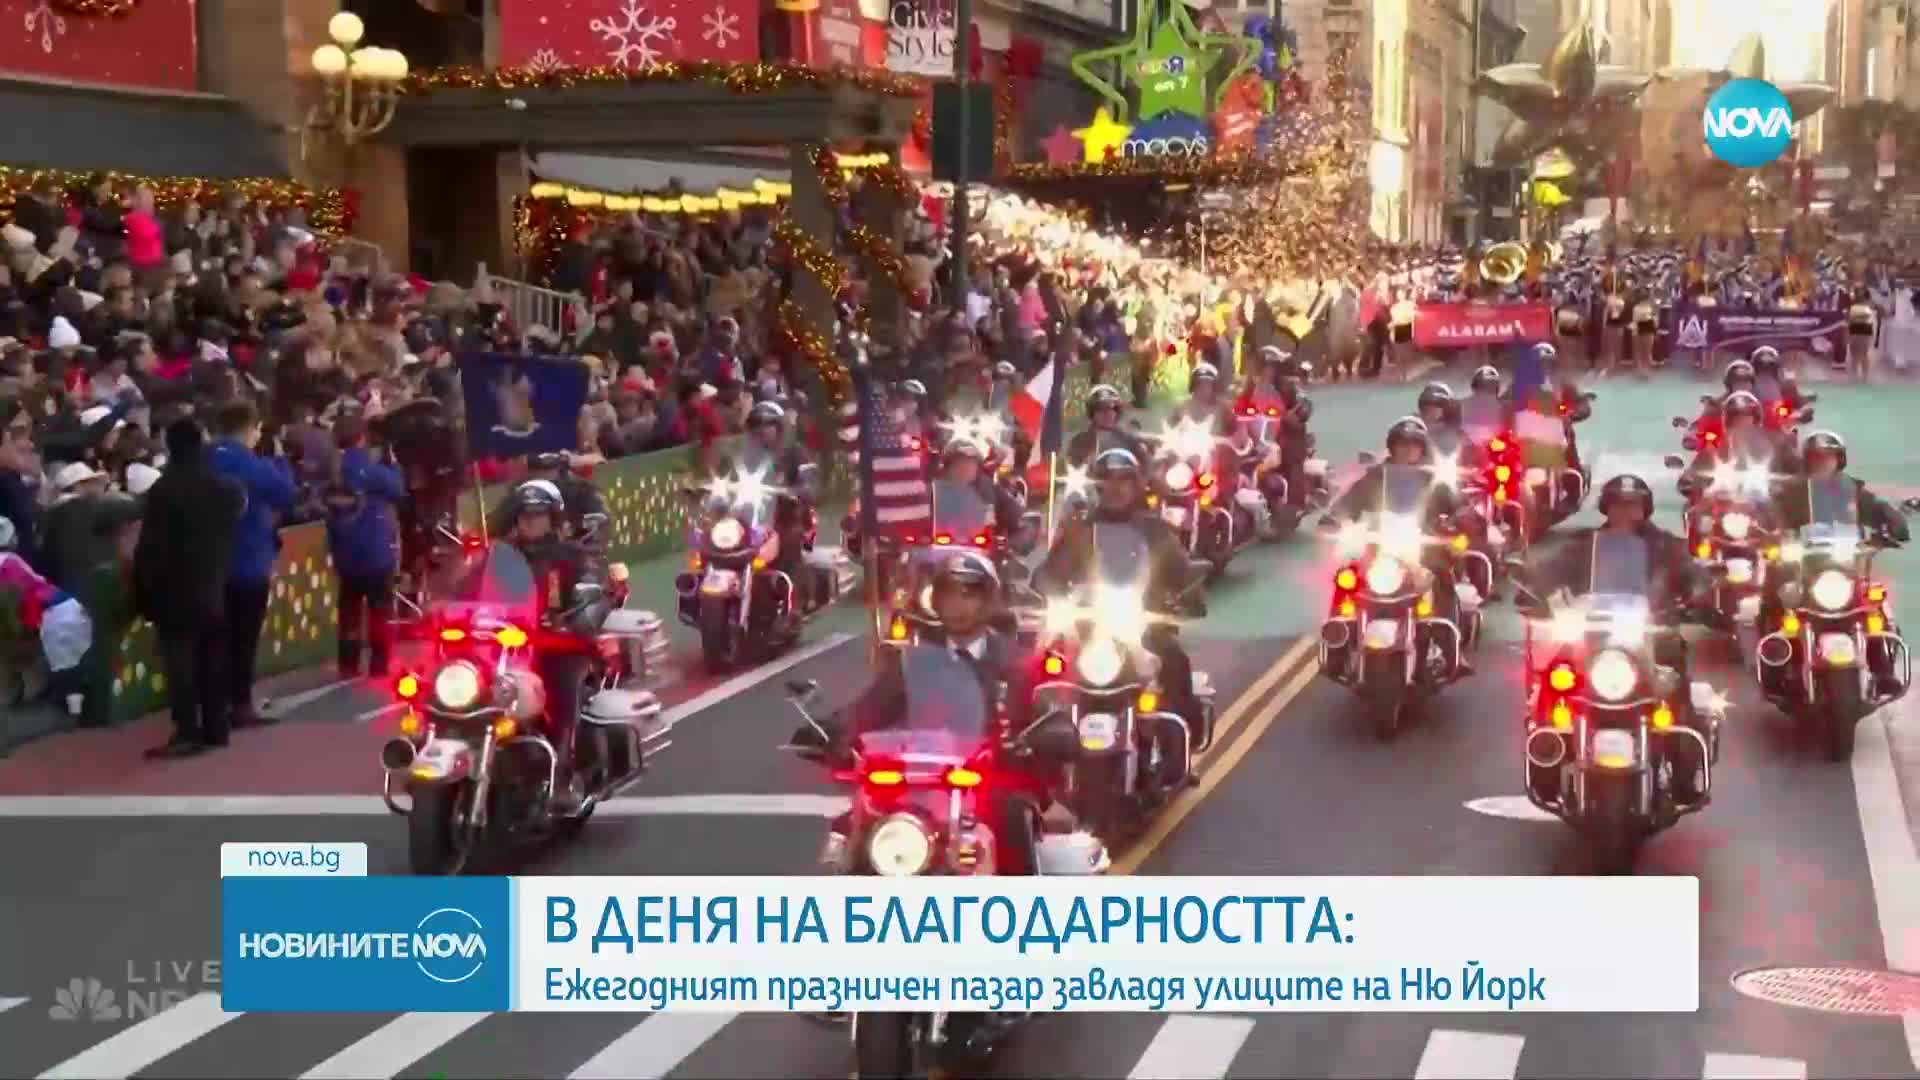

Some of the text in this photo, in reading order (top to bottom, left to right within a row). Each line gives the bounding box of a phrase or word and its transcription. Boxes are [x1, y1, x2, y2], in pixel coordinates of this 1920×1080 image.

[890, 1, 953, 30] Give
[887, 29, 954, 65] Style
[1121, 130, 1208, 159] macy's
